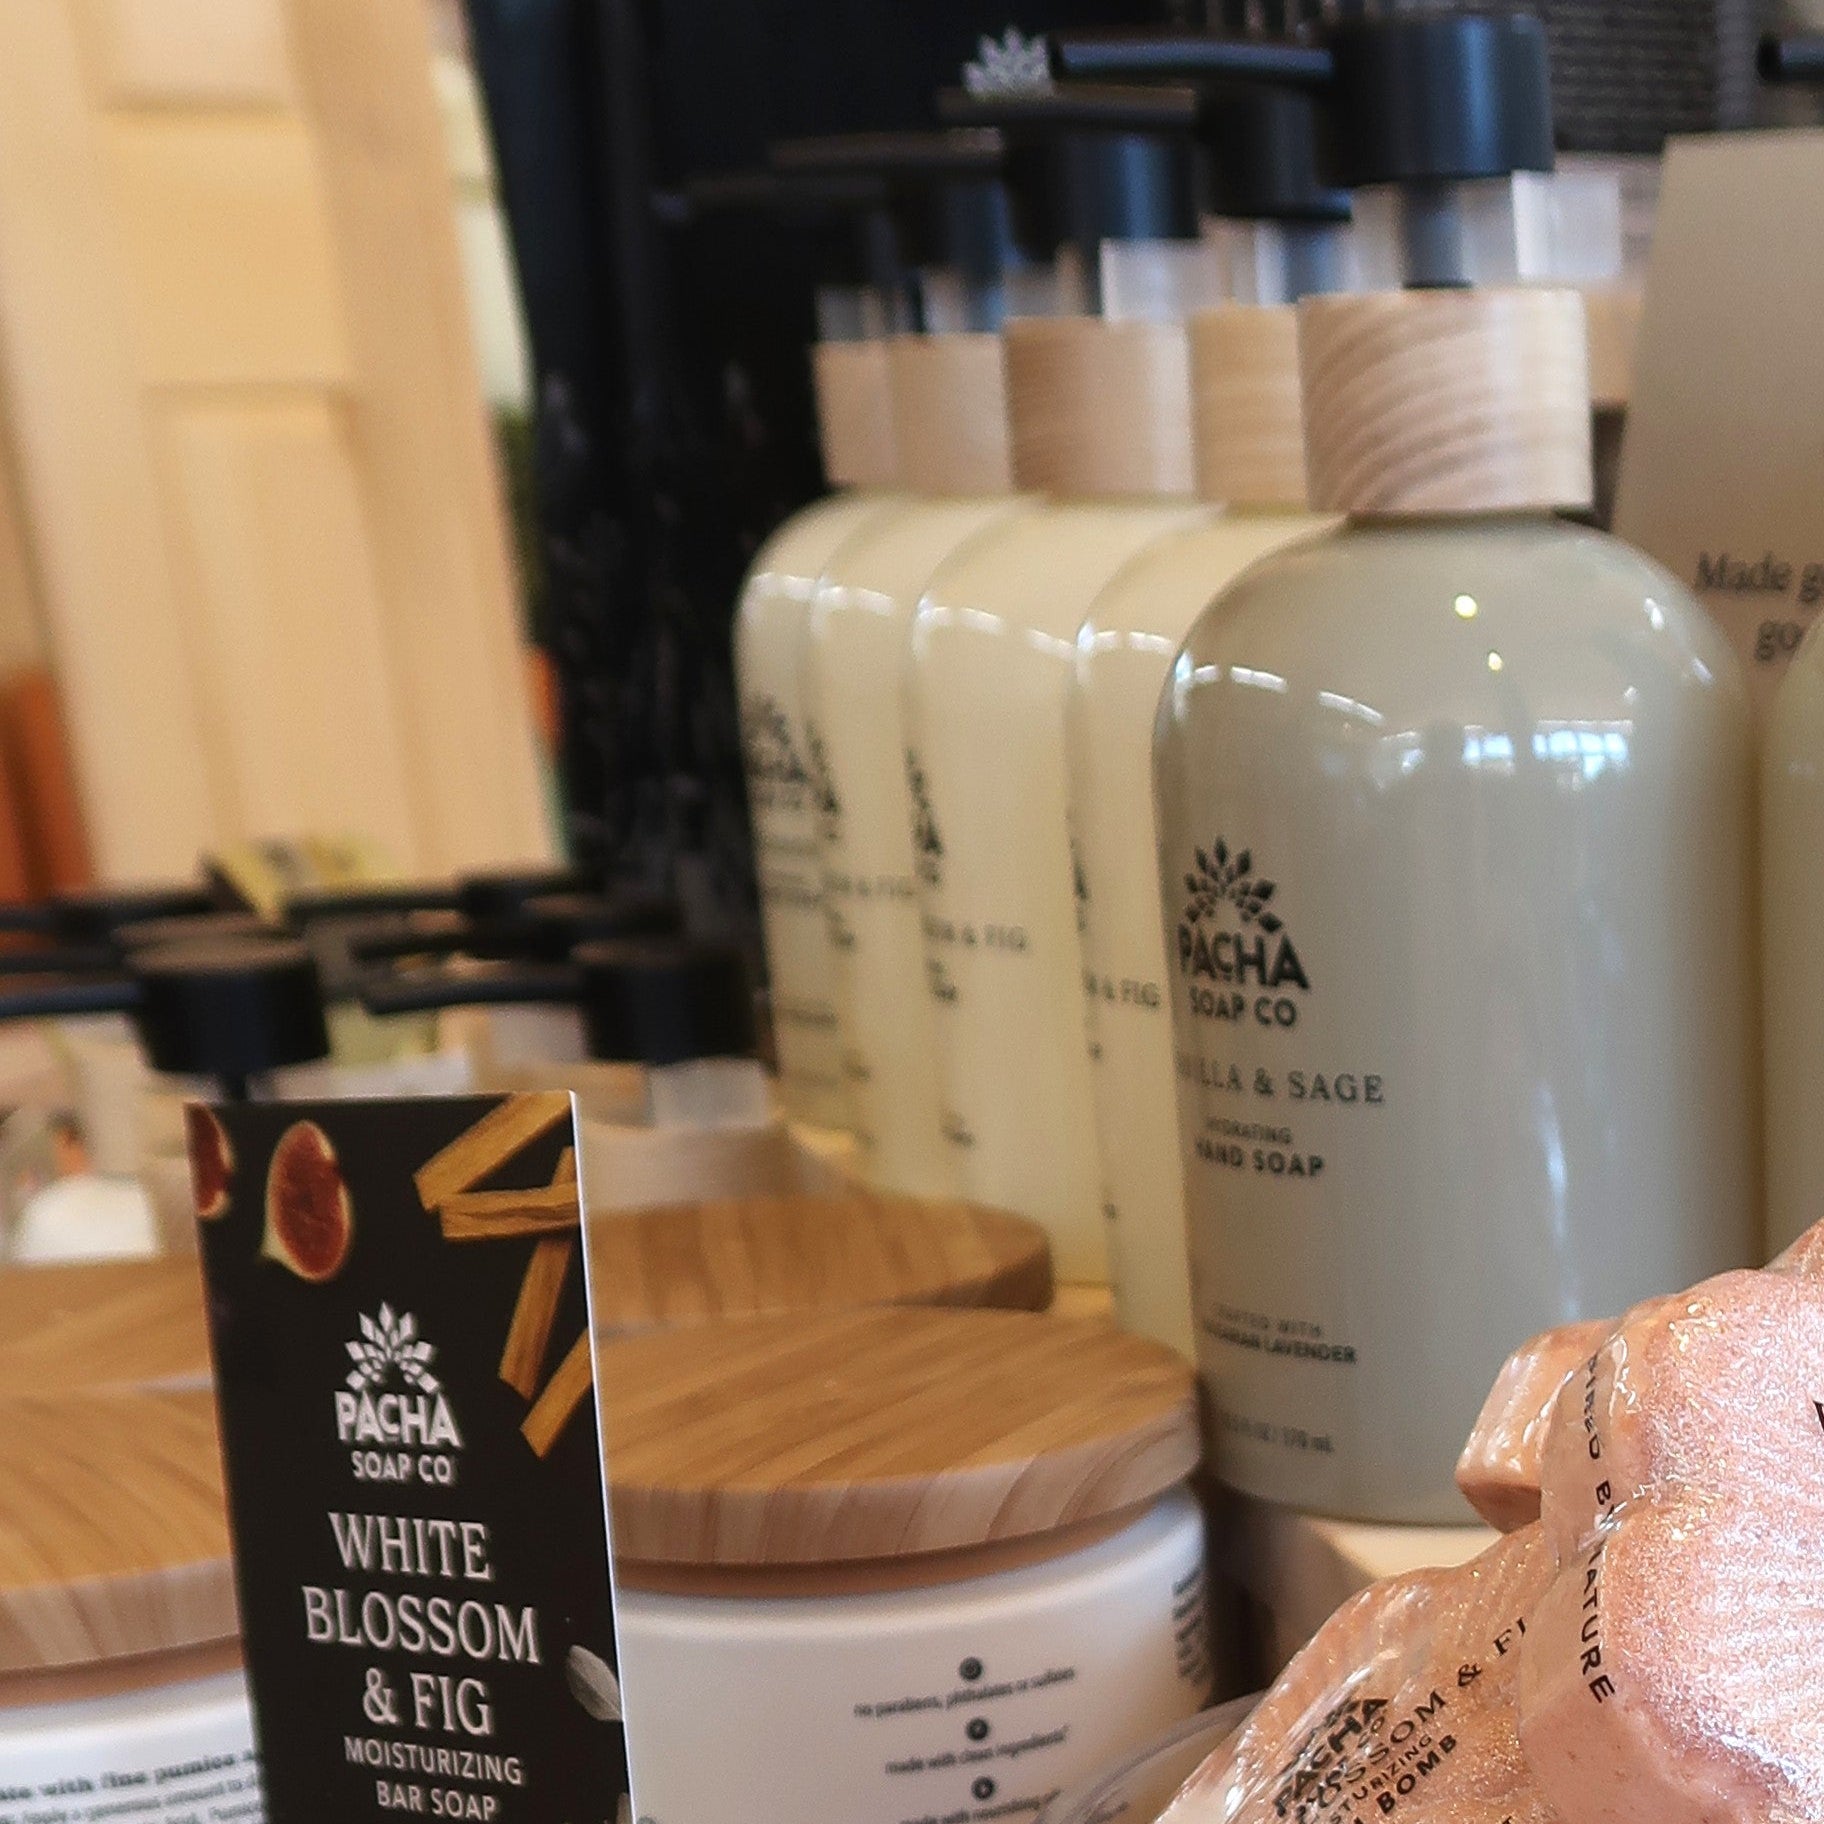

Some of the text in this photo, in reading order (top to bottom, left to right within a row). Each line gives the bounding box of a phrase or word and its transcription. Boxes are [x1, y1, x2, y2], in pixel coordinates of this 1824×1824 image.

[1697, 553, 1792, 594] Made
[1178, 923, 1309, 990] PACHA
[1188, 986, 1298, 1027] SOAP CO
[1253, 1066, 1384, 1103] & SAGE
[1252, 1149, 1326, 1176] SOAP
[1266, 1338, 1357, 1364] LAVENDER
[333, 1389, 463, 1449] PACHA
[351, 1450, 453, 1484] SOAP CO
[328, 1511, 494, 1582] WHITE
[302, 1585, 542, 1665] BLOSSOM
[1456, 1661, 1482, 1688] &
[1493, 1614, 1528, 1658] FI
[1580, 1540, 1618, 1705] ATURE
[362, 1667, 493, 1737] & FIG
[344, 1736, 523, 1786] MOISTURIZING
[1274, 1698, 1390, 1818] PACHA
[1376, 1734, 1457, 1815] BOMB
[376, 1779, 496, 1821] BAR SOAP
